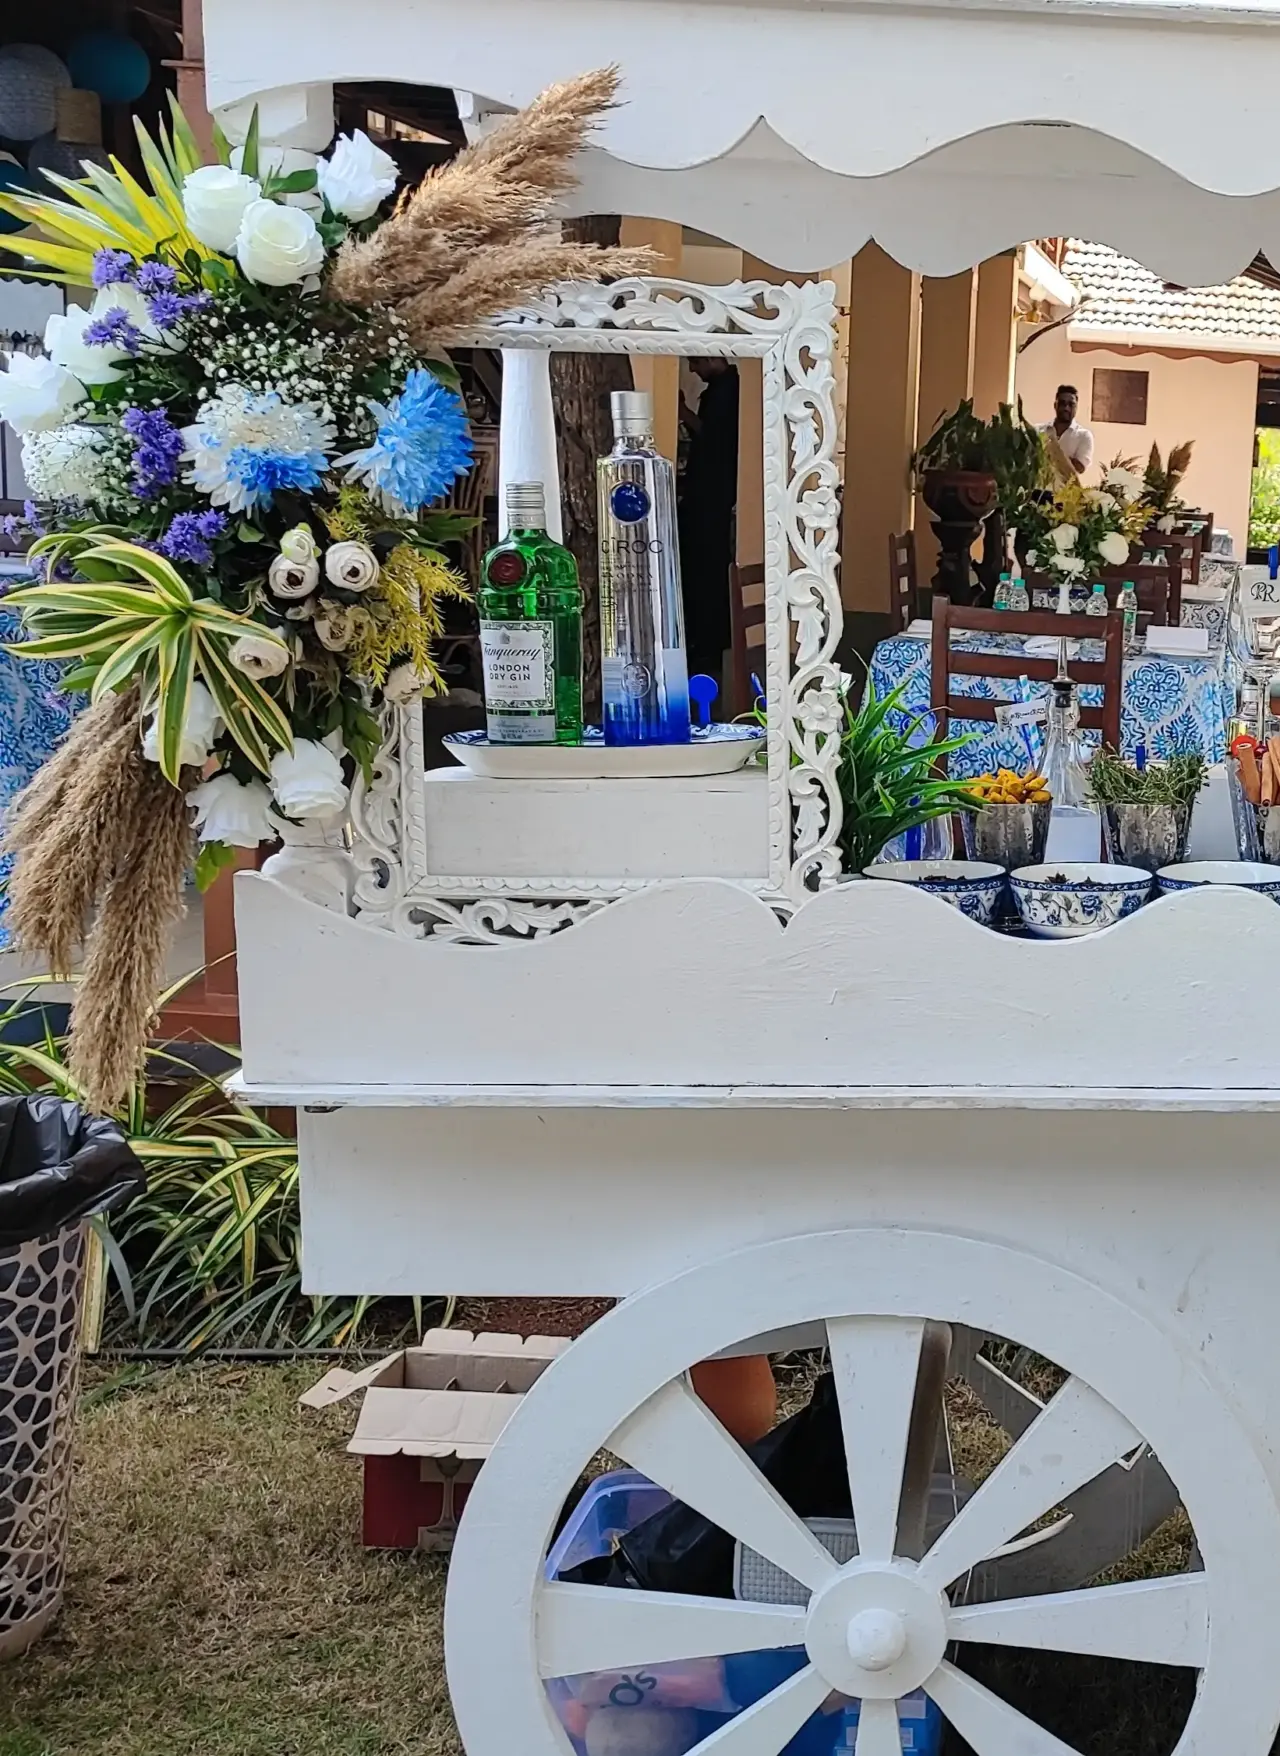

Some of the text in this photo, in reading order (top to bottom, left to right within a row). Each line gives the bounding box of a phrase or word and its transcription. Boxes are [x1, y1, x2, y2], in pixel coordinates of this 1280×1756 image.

[489, 664, 530, 672] LONDON
[489, 673, 531, 681] DRY GIN
